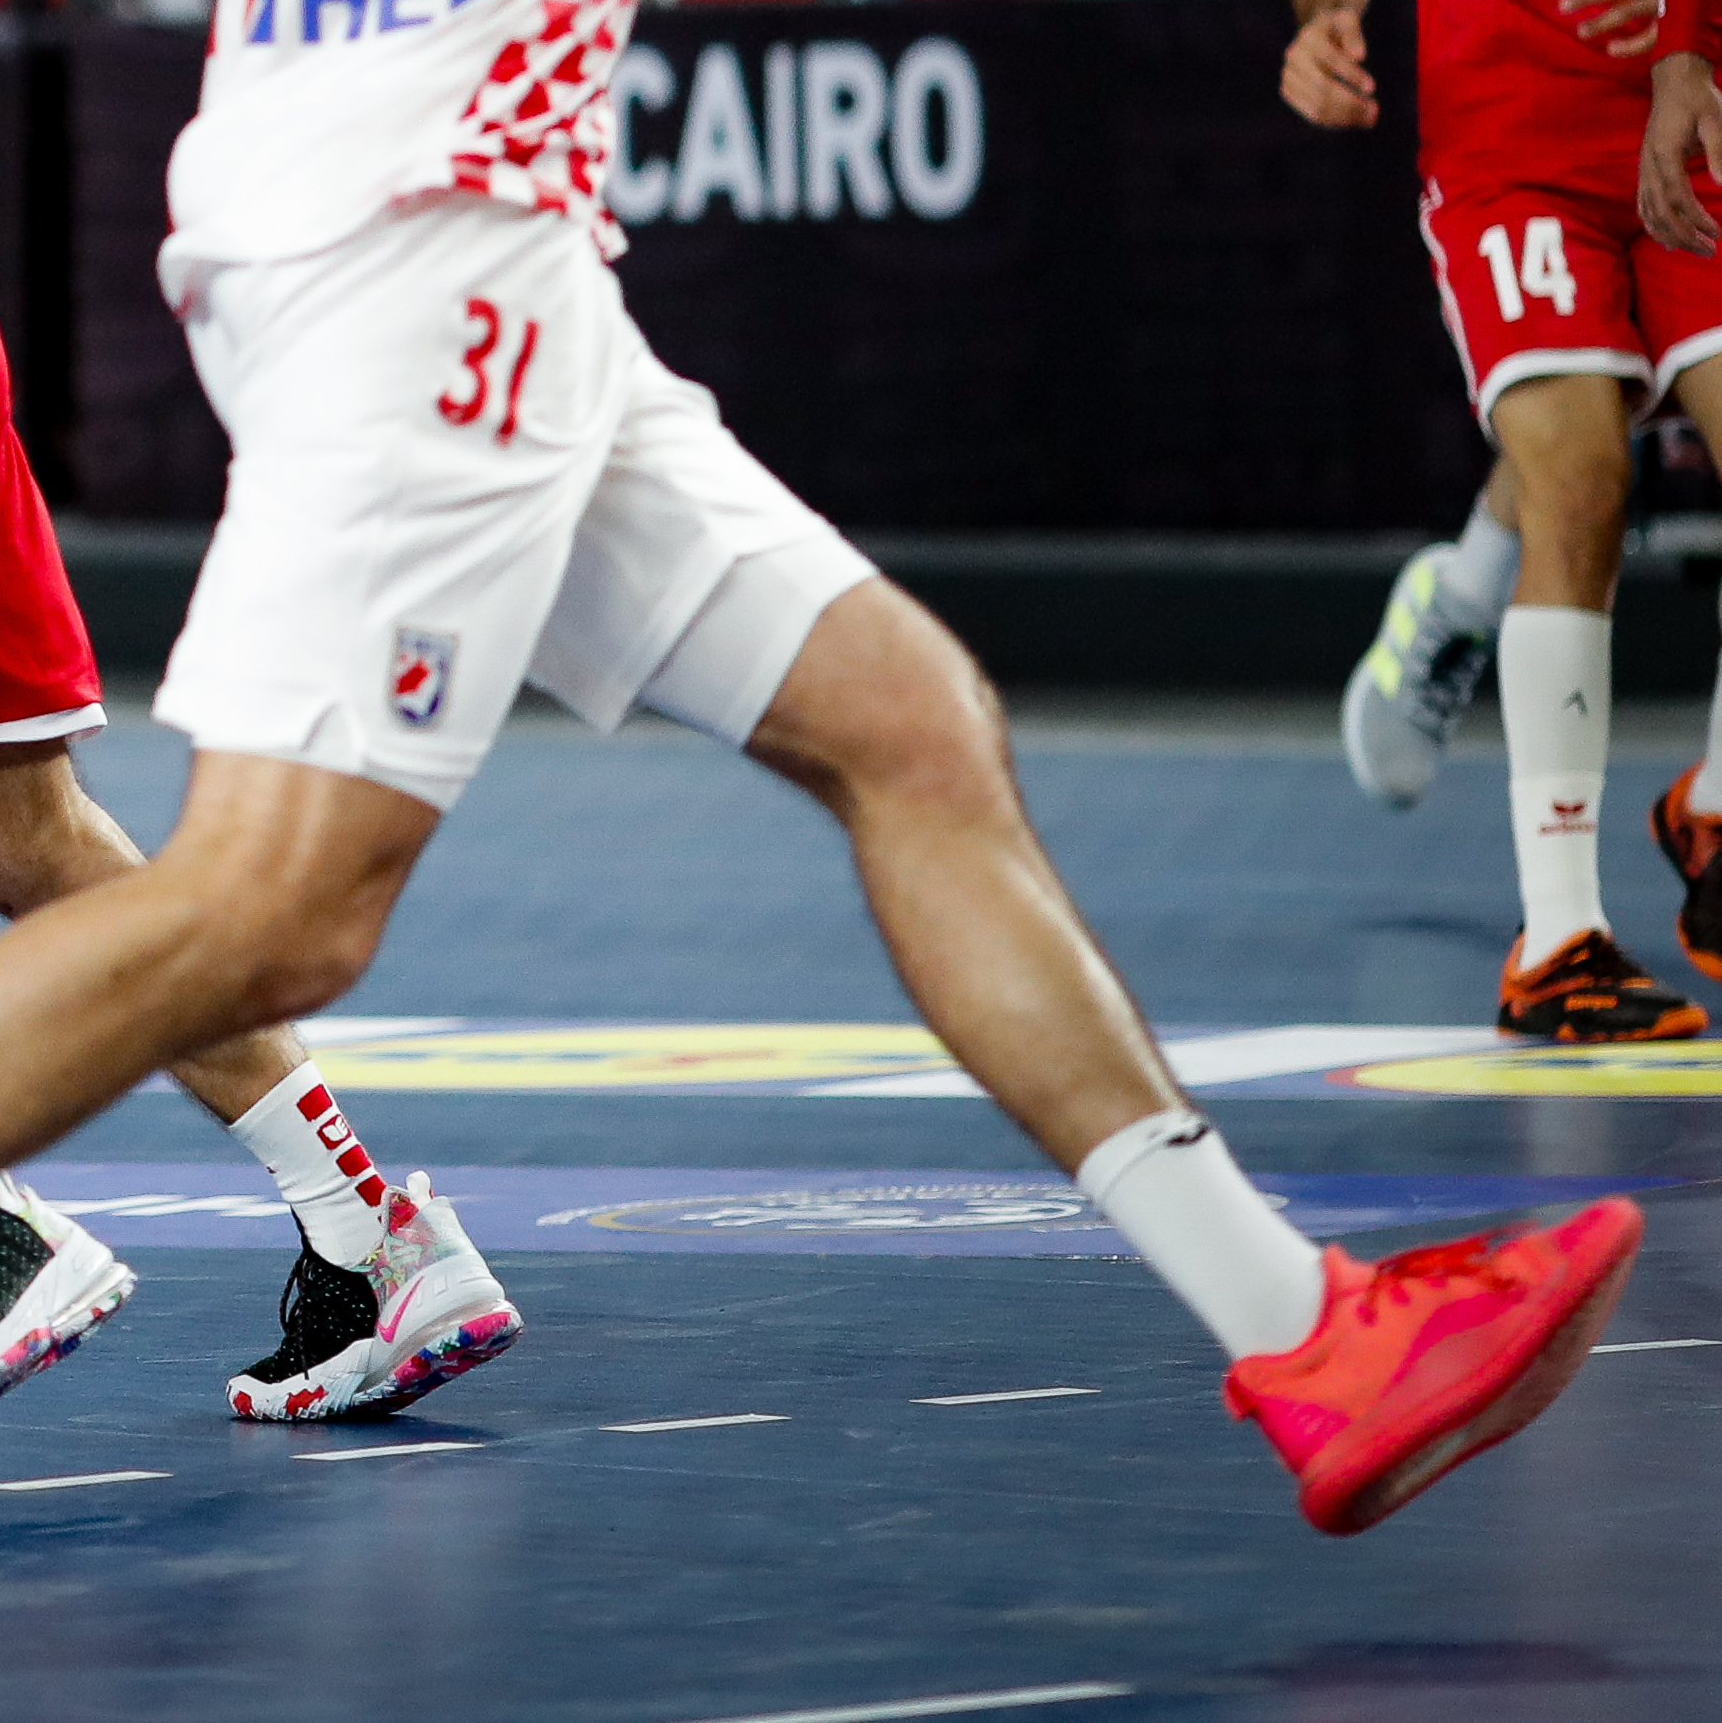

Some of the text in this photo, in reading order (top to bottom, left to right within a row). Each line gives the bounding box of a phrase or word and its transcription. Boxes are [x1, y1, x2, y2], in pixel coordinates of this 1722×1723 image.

[605, 33, 986, 223] CAIRO
[1480, 214, 1576, 322] 14
[436, 296, 540, 449] 31
